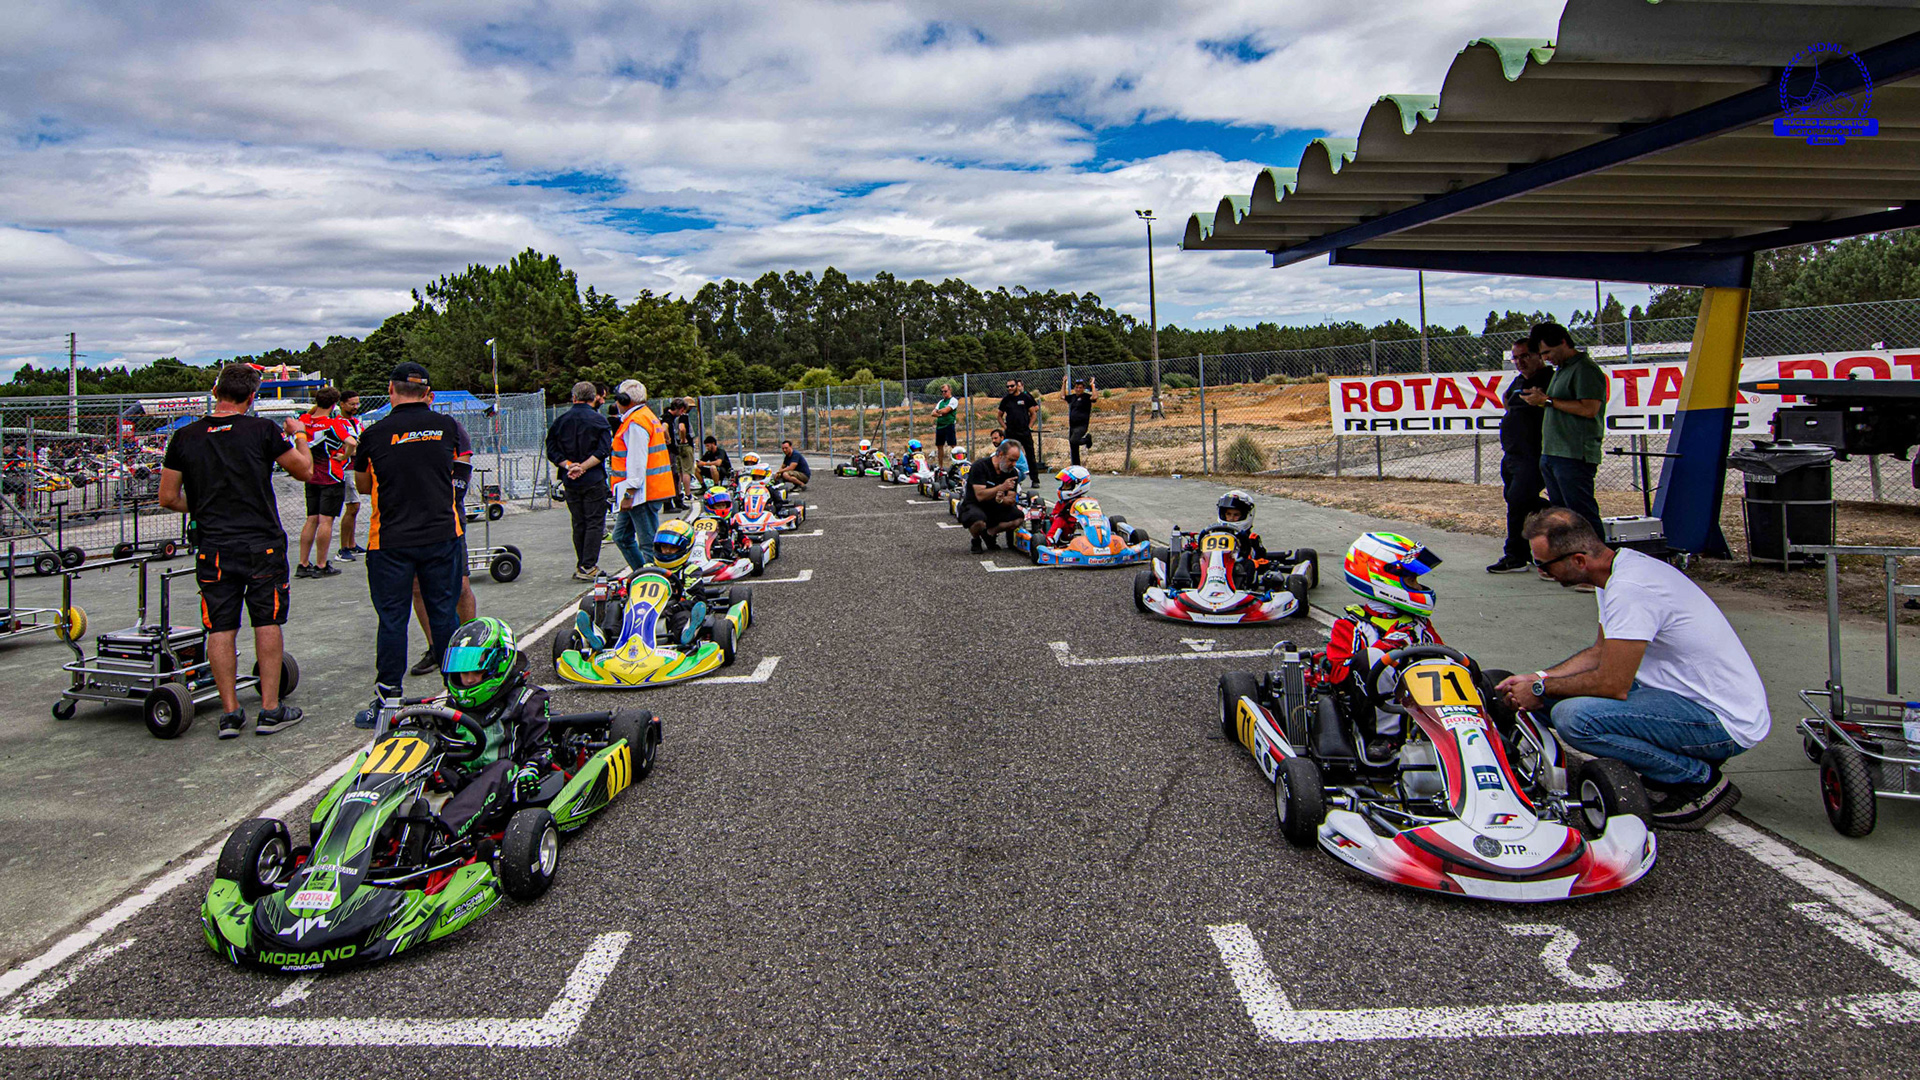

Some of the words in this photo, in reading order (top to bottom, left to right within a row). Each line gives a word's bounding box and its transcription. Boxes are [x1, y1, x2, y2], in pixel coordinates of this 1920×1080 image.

[1341, 375, 1504, 413] ROTAX
[408, 430, 443, 438] RACING
[1079, 502, 1099, 511] 12
[696, 522, 713, 531] 88
[1206, 537, 1229, 550] 99
[639, 583, 660, 598] 10
[1416, 671, 1469, 702] 71
[1240, 705, 1252, 749] 71
[1445, 716, 1481, 725] ROTAX
[370, 739, 419, 773] 11
[610, 747, 627, 795] 11
[1476, 772, 1500, 783] FTB
[1504, 845, 1527, 855] JTP
[297, 892, 332, 902] ROTAX
[454, 890, 484, 913] RACING
[259, 945, 356, 965] MORIANO
